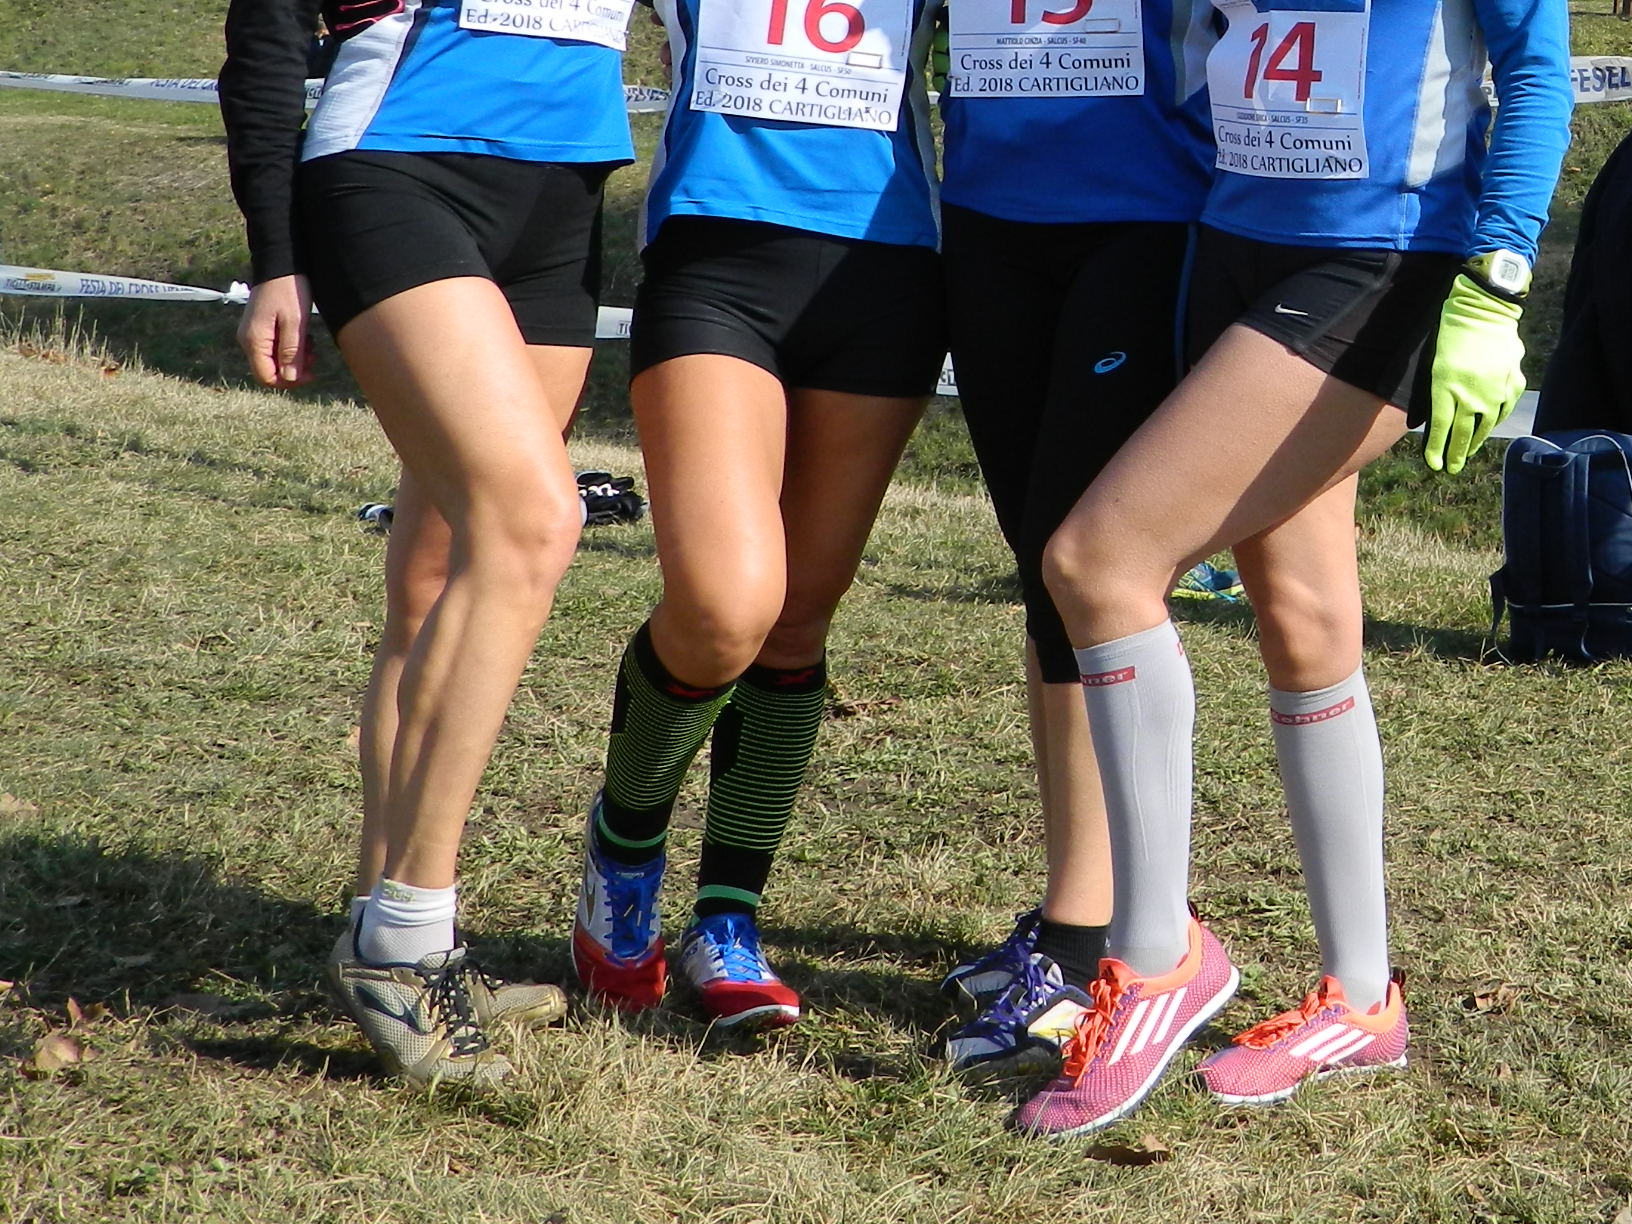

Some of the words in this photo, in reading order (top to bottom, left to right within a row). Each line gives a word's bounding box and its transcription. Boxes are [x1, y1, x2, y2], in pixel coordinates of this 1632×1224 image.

[499, 12, 543, 30] 2018
[587, 0, 625, 21] Comuni
[961, 53, 1002, 70] Cross
[1009, 52, 1033, 69] dei
[1040, 53, 1052, 69] 4
[1059, 53, 1131, 69] Comuni
[1244, 22, 1322, 102] 14
[705, 68, 753, 89] Cross
[760, 73, 788, 93] dei
[795, 78, 808, 95] 4
[816, 81, 889, 103] Comuni
[954, 77, 973, 92] Ed.
[979, 78, 1013, 92] 2018
[1019, 76, 1139, 91] CARTIGLIANO
[695, 91, 716, 107] Ed.
[722, 93, 762, 112] 2018
[769, 100, 892, 125] CARTIGLIANO
[1218, 126, 1242, 144] Cross
[1244, 129, 1261, 147] dei
[1265, 131, 1274, 148] 4
[1280, 133, 1352, 150] Comuni
[1229, 151, 1248, 168] 2018
[1251, 155, 1362, 173] CARTIGLIANO
